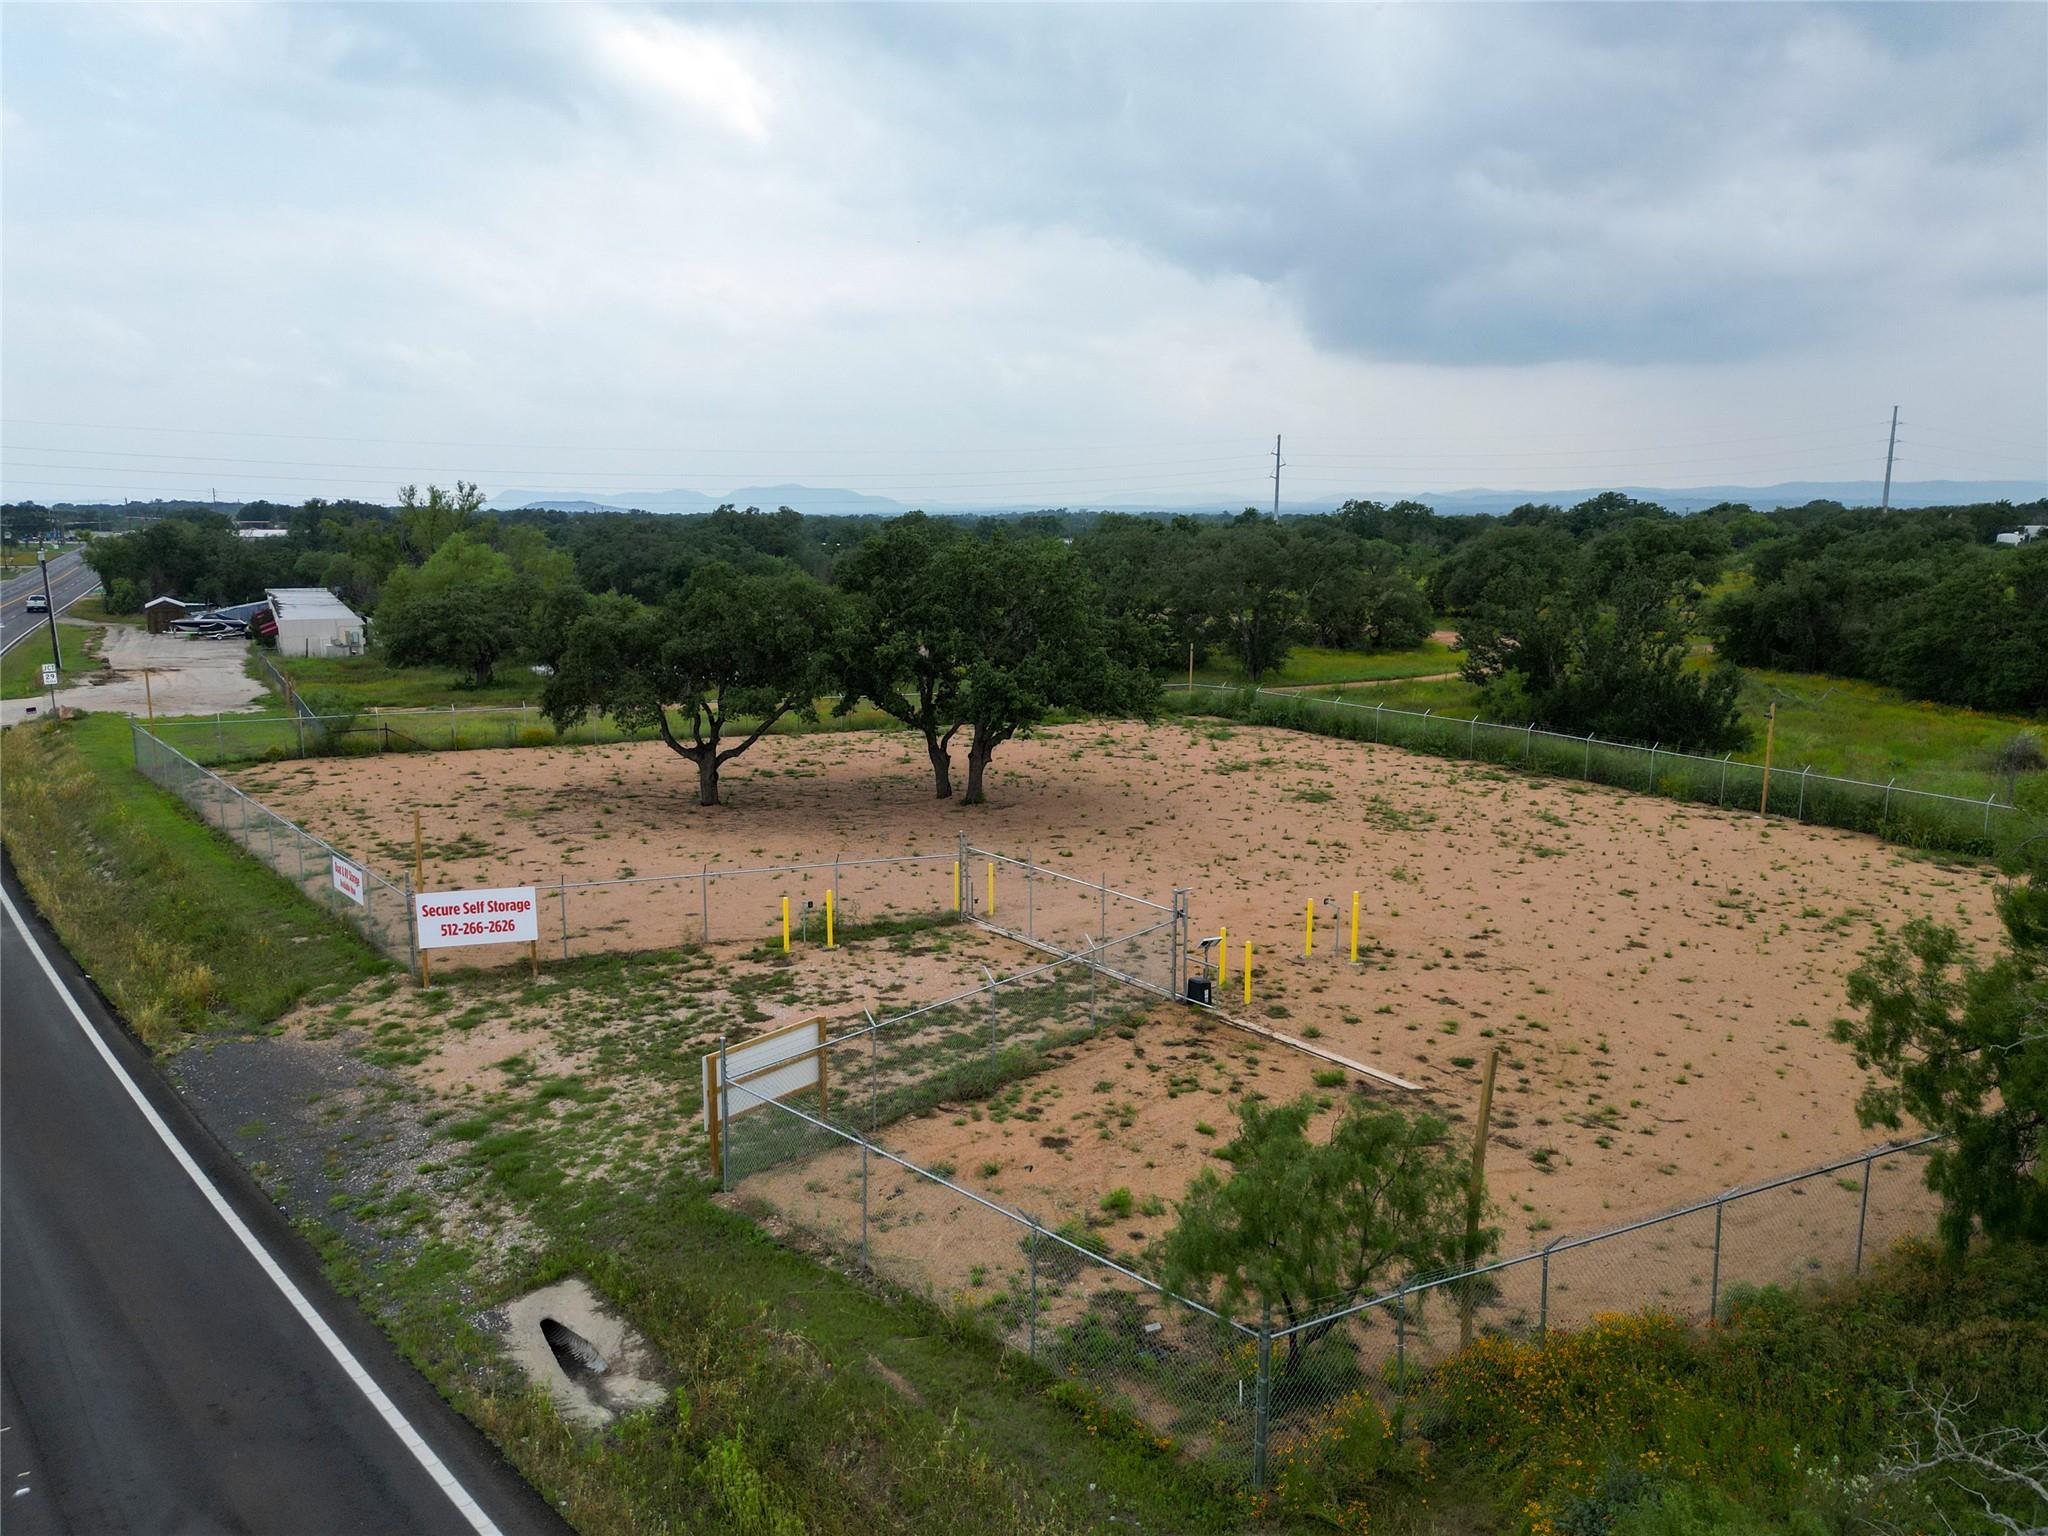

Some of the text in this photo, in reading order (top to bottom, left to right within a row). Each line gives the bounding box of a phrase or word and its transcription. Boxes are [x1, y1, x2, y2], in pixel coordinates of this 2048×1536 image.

[422, 900, 531, 917] Secure Self Storage
[441, 919, 515, 936] 512-266-2626
